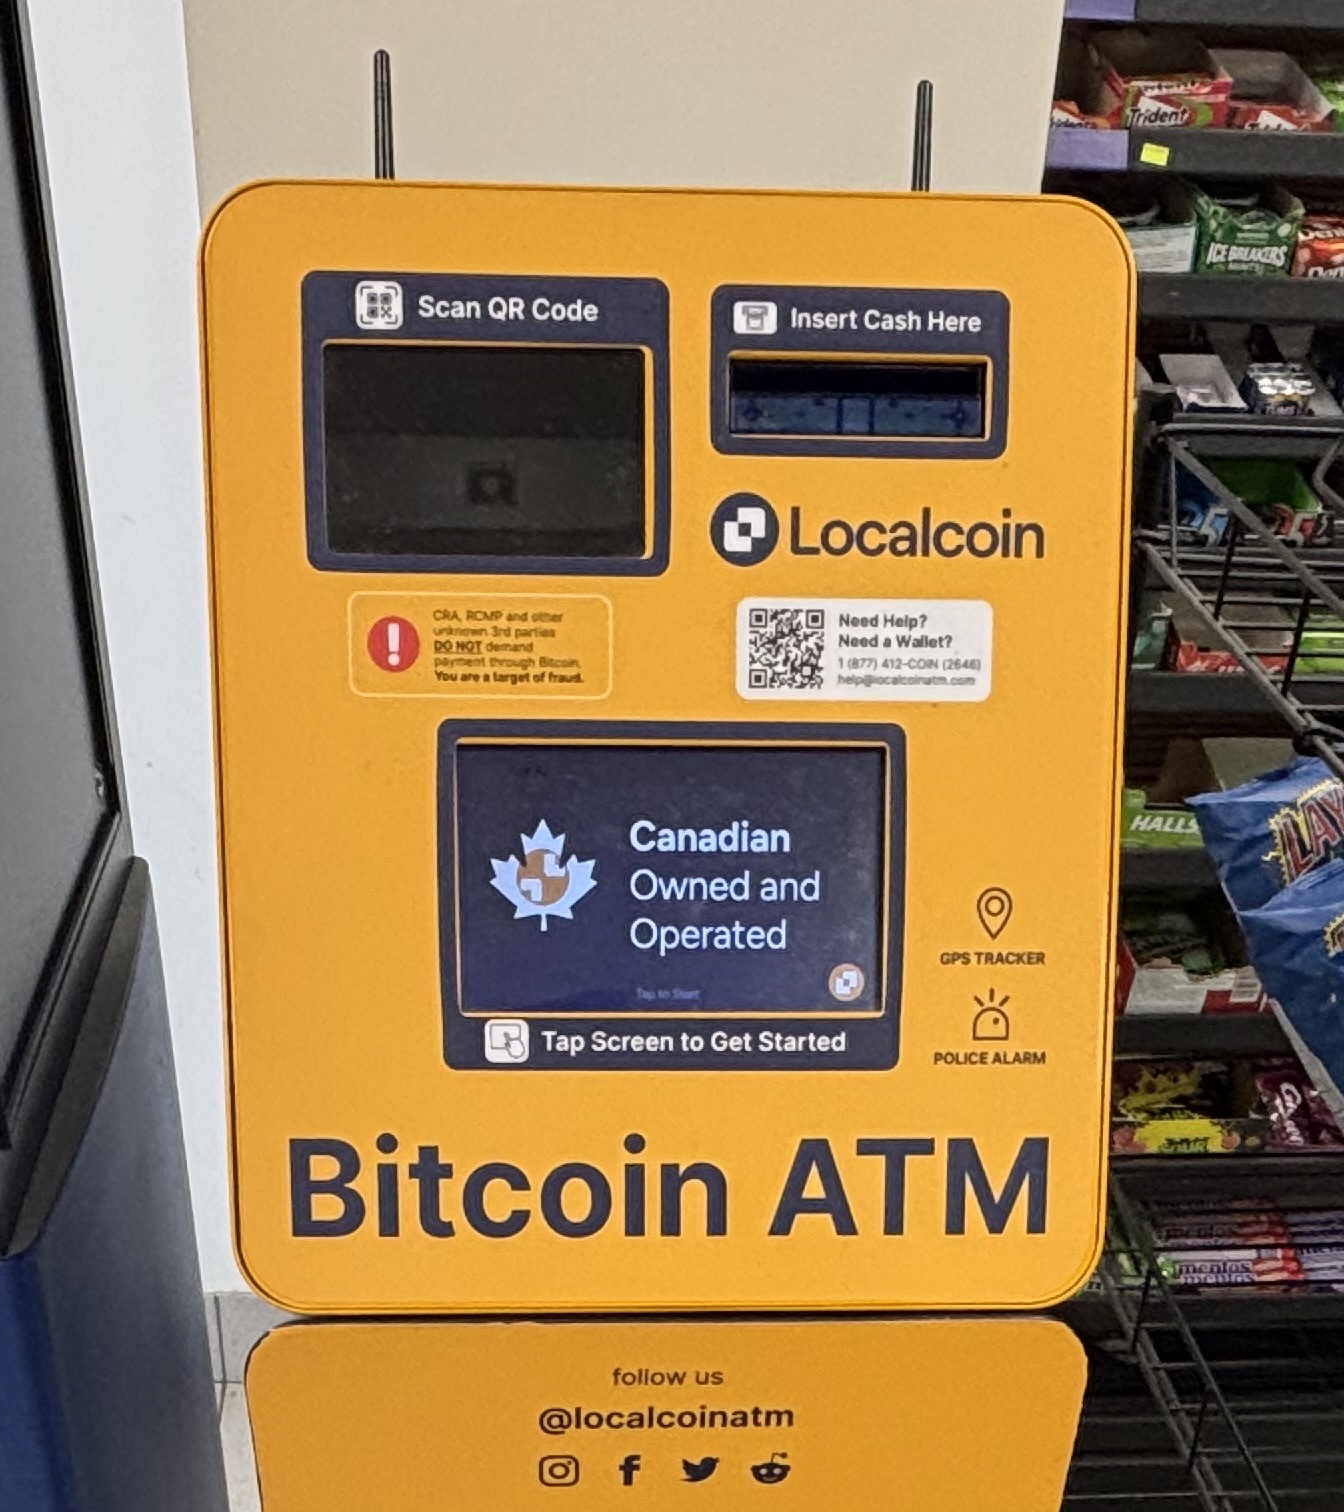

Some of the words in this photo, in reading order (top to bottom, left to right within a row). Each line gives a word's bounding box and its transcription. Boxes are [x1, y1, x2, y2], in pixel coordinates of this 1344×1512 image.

[1128, 108, 1188, 126] Trident
[1206, 242, 1228, 264] ICE
[1228, 245, 1288, 267] BREAKERS
[418, 295, 482, 322] Scan
[488, 296, 524, 324] QR
[530, 296, 600, 323] Code
[790, 307, 856, 332] Insert
[863, 310, 924, 333] Cash
[929, 312, 982, 333] Here
[790, 506, 1044, 559] Localcoin
[466, 611, 503, 622] RCMP
[506, 611, 528, 622] and
[532, 611, 563, 622] other
[838, 614, 878, 628] Need
[883, 614, 927, 631] Help?
[433, 626, 487, 637] unknown
[492, 626, 511, 637] 3rd
[515, 627, 555, 639] parties
[838, 634, 878, 648] Need
[883, 637, 891, 648] a
[896, 635, 953, 648] Wallet?
[434, 640, 453, 652] DO
[456, 641, 481, 652] NOT
[485, 641, 533, 652] demand
[434, 658, 485, 668] payment
[490, 658, 535, 670] through
[838, 659, 843, 669] 1
[847, 658, 877, 671] (877)
[881, 659, 939, 670] 412-COIN
[435, 671, 457, 682] You
[460, 673, 480, 682] are
[483, 673, 490, 682] a
[493, 672, 529, 685] target
[533, 672, 545, 682] of
[548, 672, 584, 683] fraud.
[630, 820, 791, 854] Canadian
[630, 870, 748, 902] Owned
[759, 870, 820, 902] and
[630, 918, 788, 955] Operated
[938, 950, 969, 966] GPS
[974, 950, 1046, 966] TRACKER
[541, 1030, 582, 1056] Tap
[591, 1030, 674, 1052] Screen
[680, 1032, 703, 1052] to
[710, 1031, 752, 1052] Get
[758, 1030, 846, 1052] Started
[932, 1050, 985, 1065] POLICE
[989, 1050, 1046, 1065] ALARM
[289, 1132, 727, 1238] Bitcoin
[768, 1136, 1050, 1238] ATM
[1178, 1262, 1251, 1274] mentos
[613, 1367, 686, 1385] follow
[695, 1370, 724, 1385] us
[539, 1405, 794, 1435] @localcoinatm
